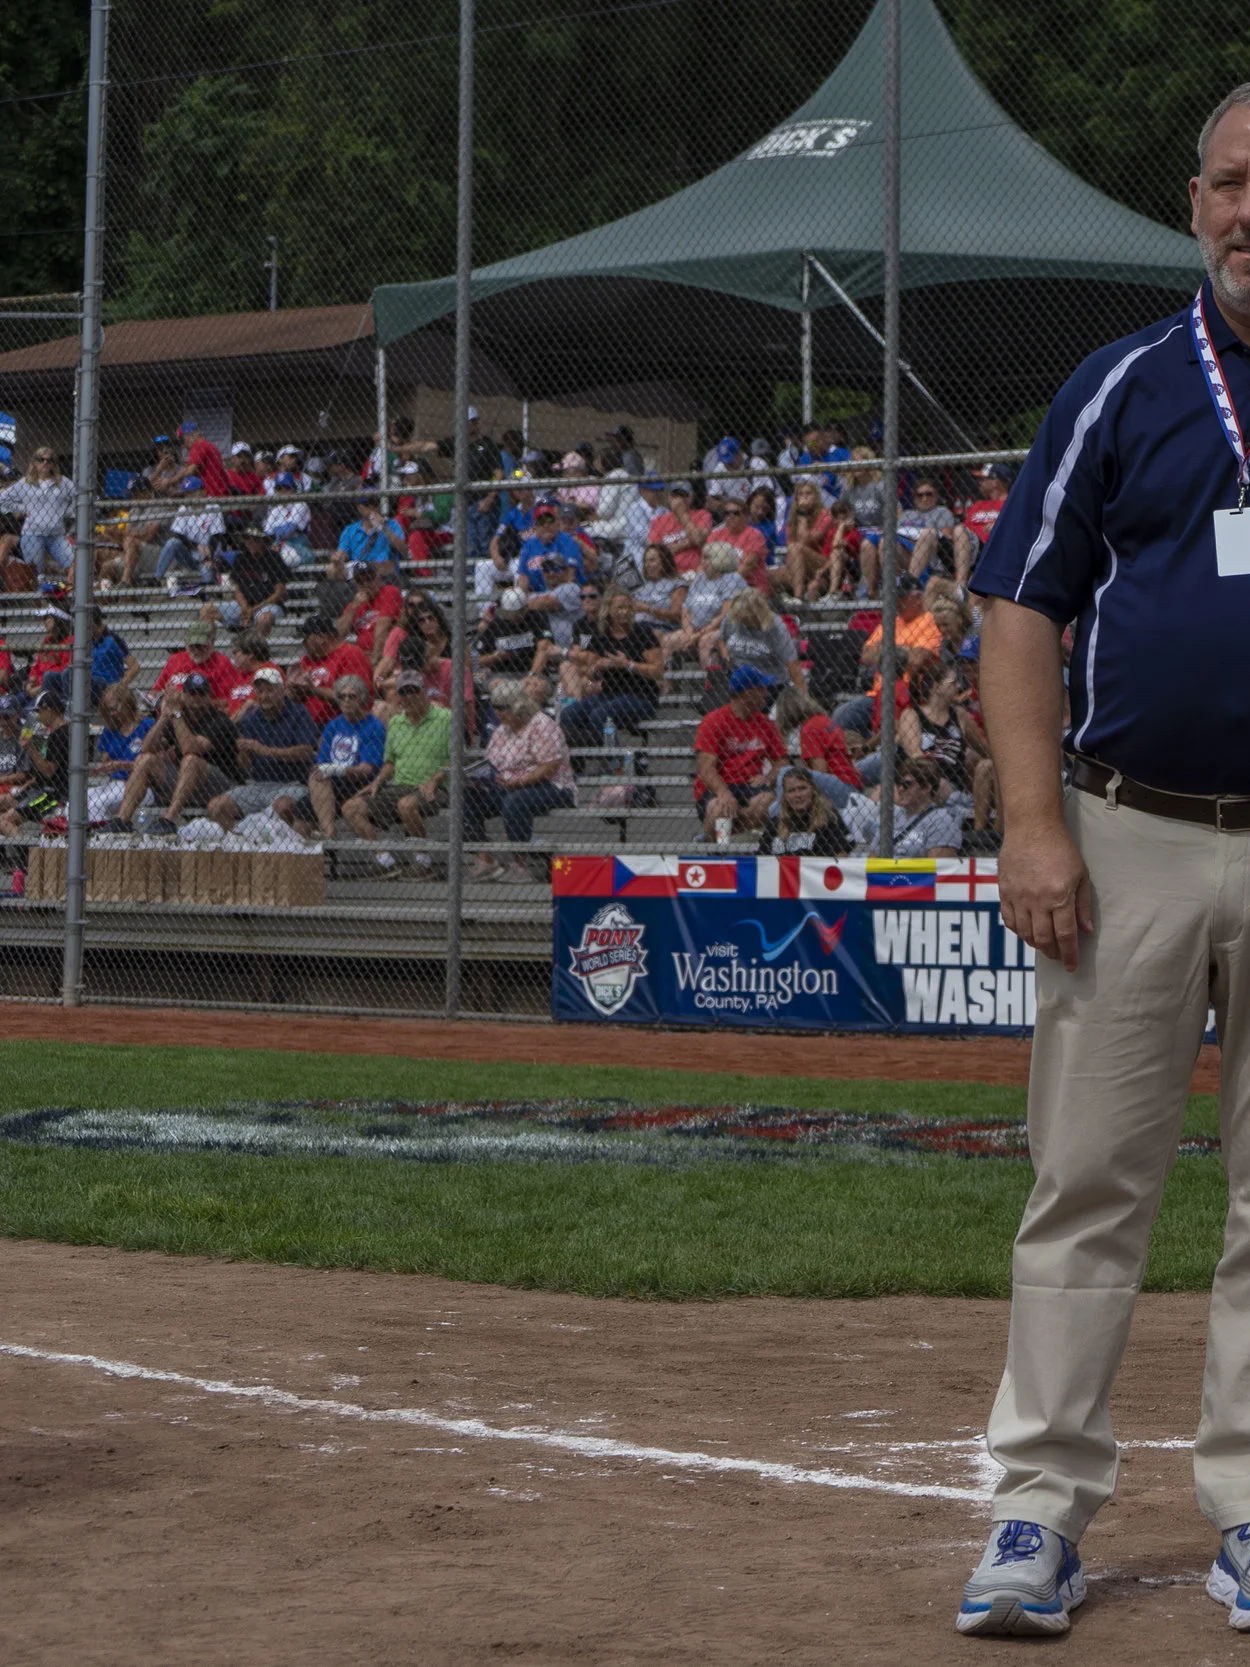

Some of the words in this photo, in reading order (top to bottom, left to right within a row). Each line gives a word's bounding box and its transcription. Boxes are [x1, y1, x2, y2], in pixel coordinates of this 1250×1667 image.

[585, 928, 640, 946] PONY
[873, 909, 990, 966] WHEN
[582, 954, 609, 972] WORLD
[609, 948, 638, 964] SERIES
[706, 942, 738, 957] visit
[671, 952, 839, 1004] Washington
[755, 994, 779, 1010] PA
